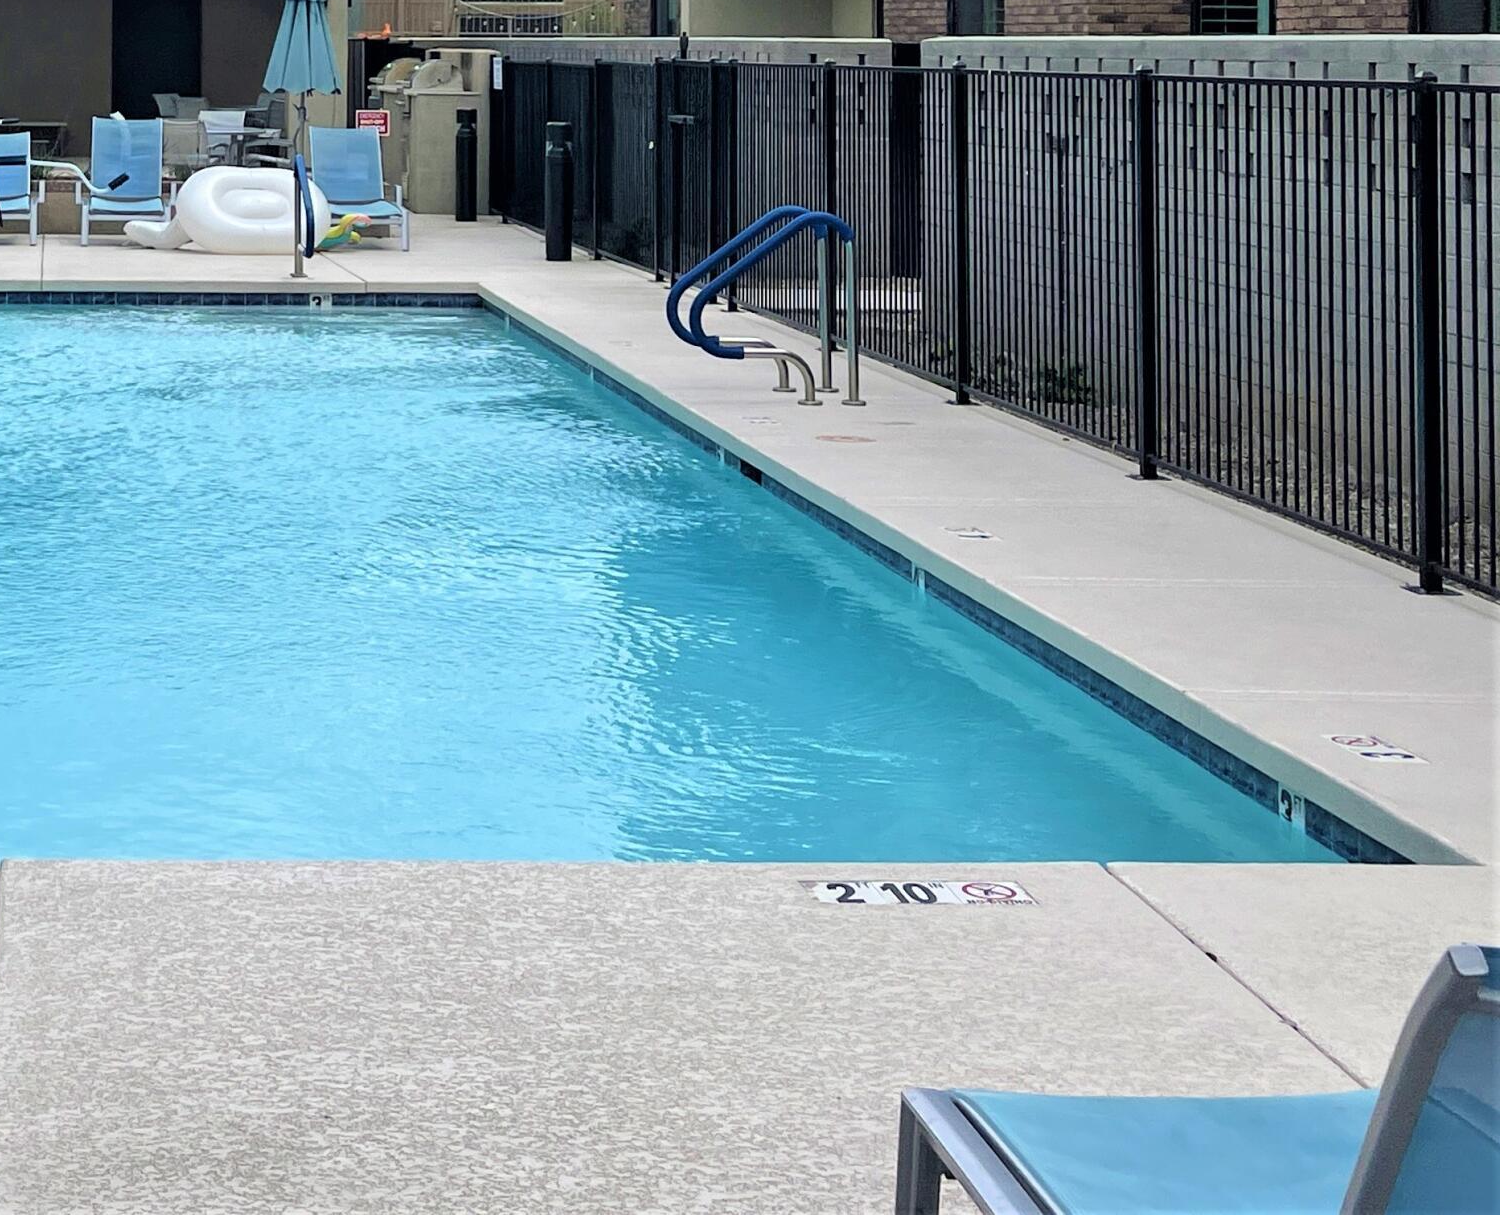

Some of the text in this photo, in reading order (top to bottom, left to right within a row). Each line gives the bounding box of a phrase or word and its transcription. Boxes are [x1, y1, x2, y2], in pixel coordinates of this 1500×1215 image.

[1280, 789, 1292, 822] 3
[826, 882, 866, 904] 2
[880, 882, 938, 904] 10
